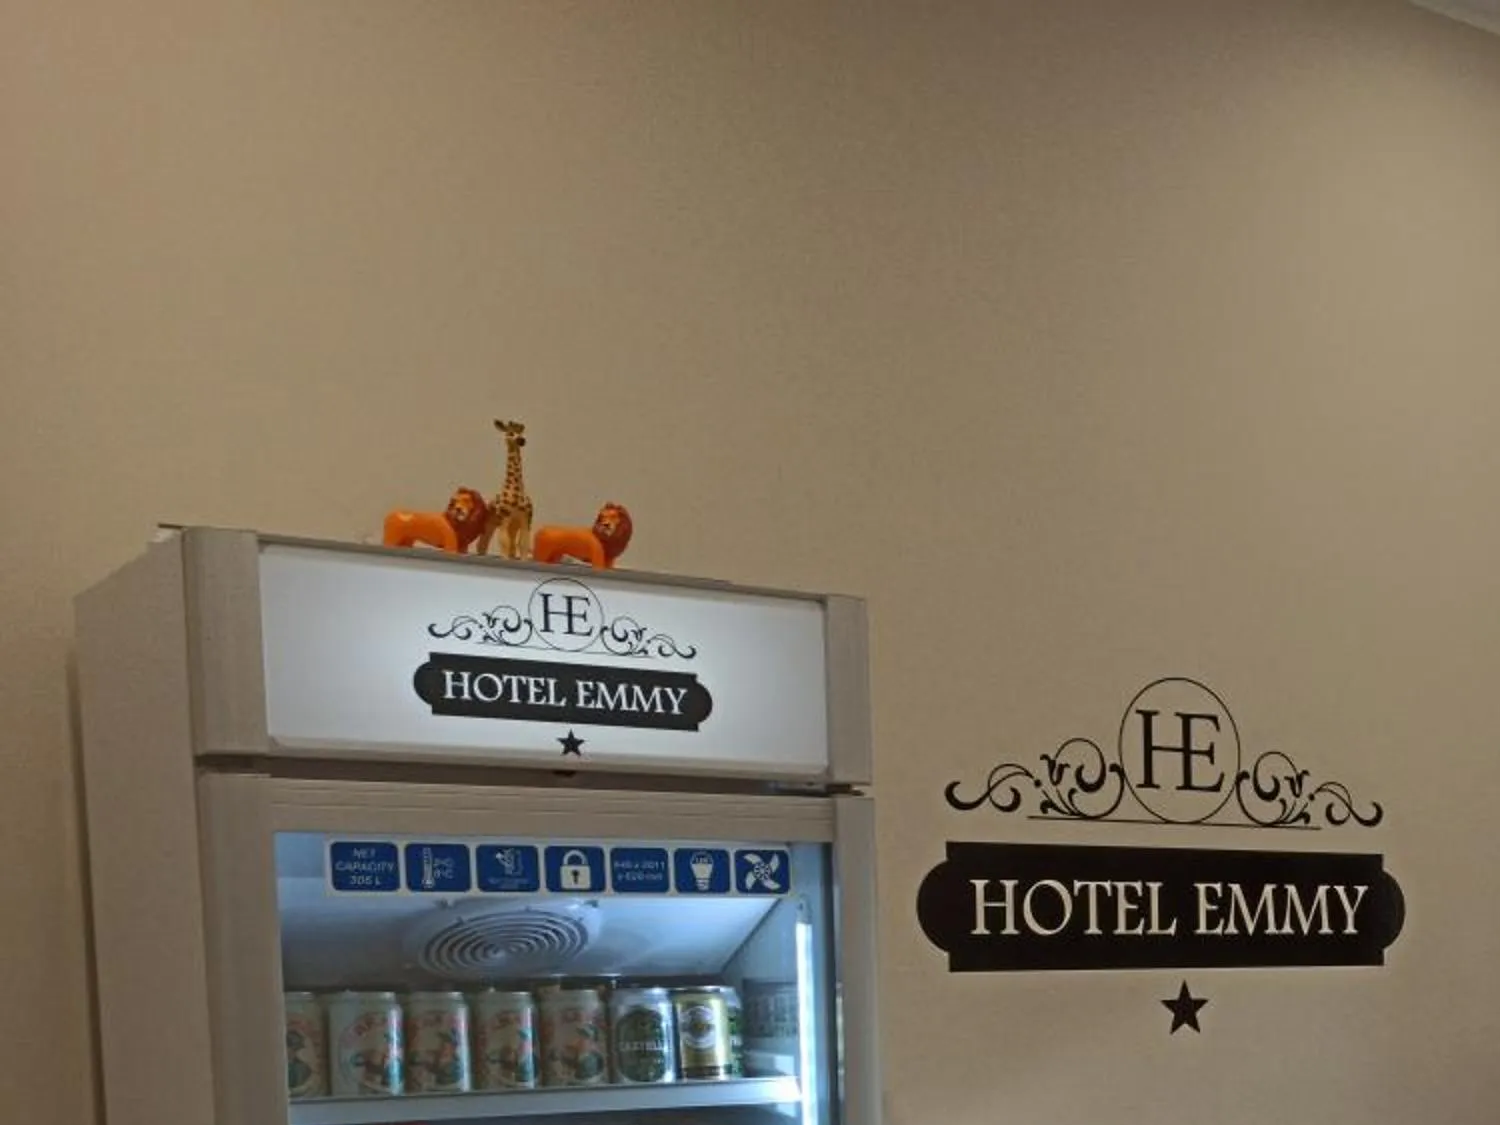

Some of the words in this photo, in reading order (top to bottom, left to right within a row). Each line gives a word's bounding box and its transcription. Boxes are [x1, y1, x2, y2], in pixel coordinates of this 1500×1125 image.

[539, 592, 593, 637] HE
[442, 669, 567, 708] HOTEL
[575, 680, 688, 715] EMMY
[1135, 709, 1226, 793] HE
[334, 860, 395, 873] CAPACITY
[969, 878, 1178, 937] HOTEL
[1193, 882, 1370, 936] EMMY
